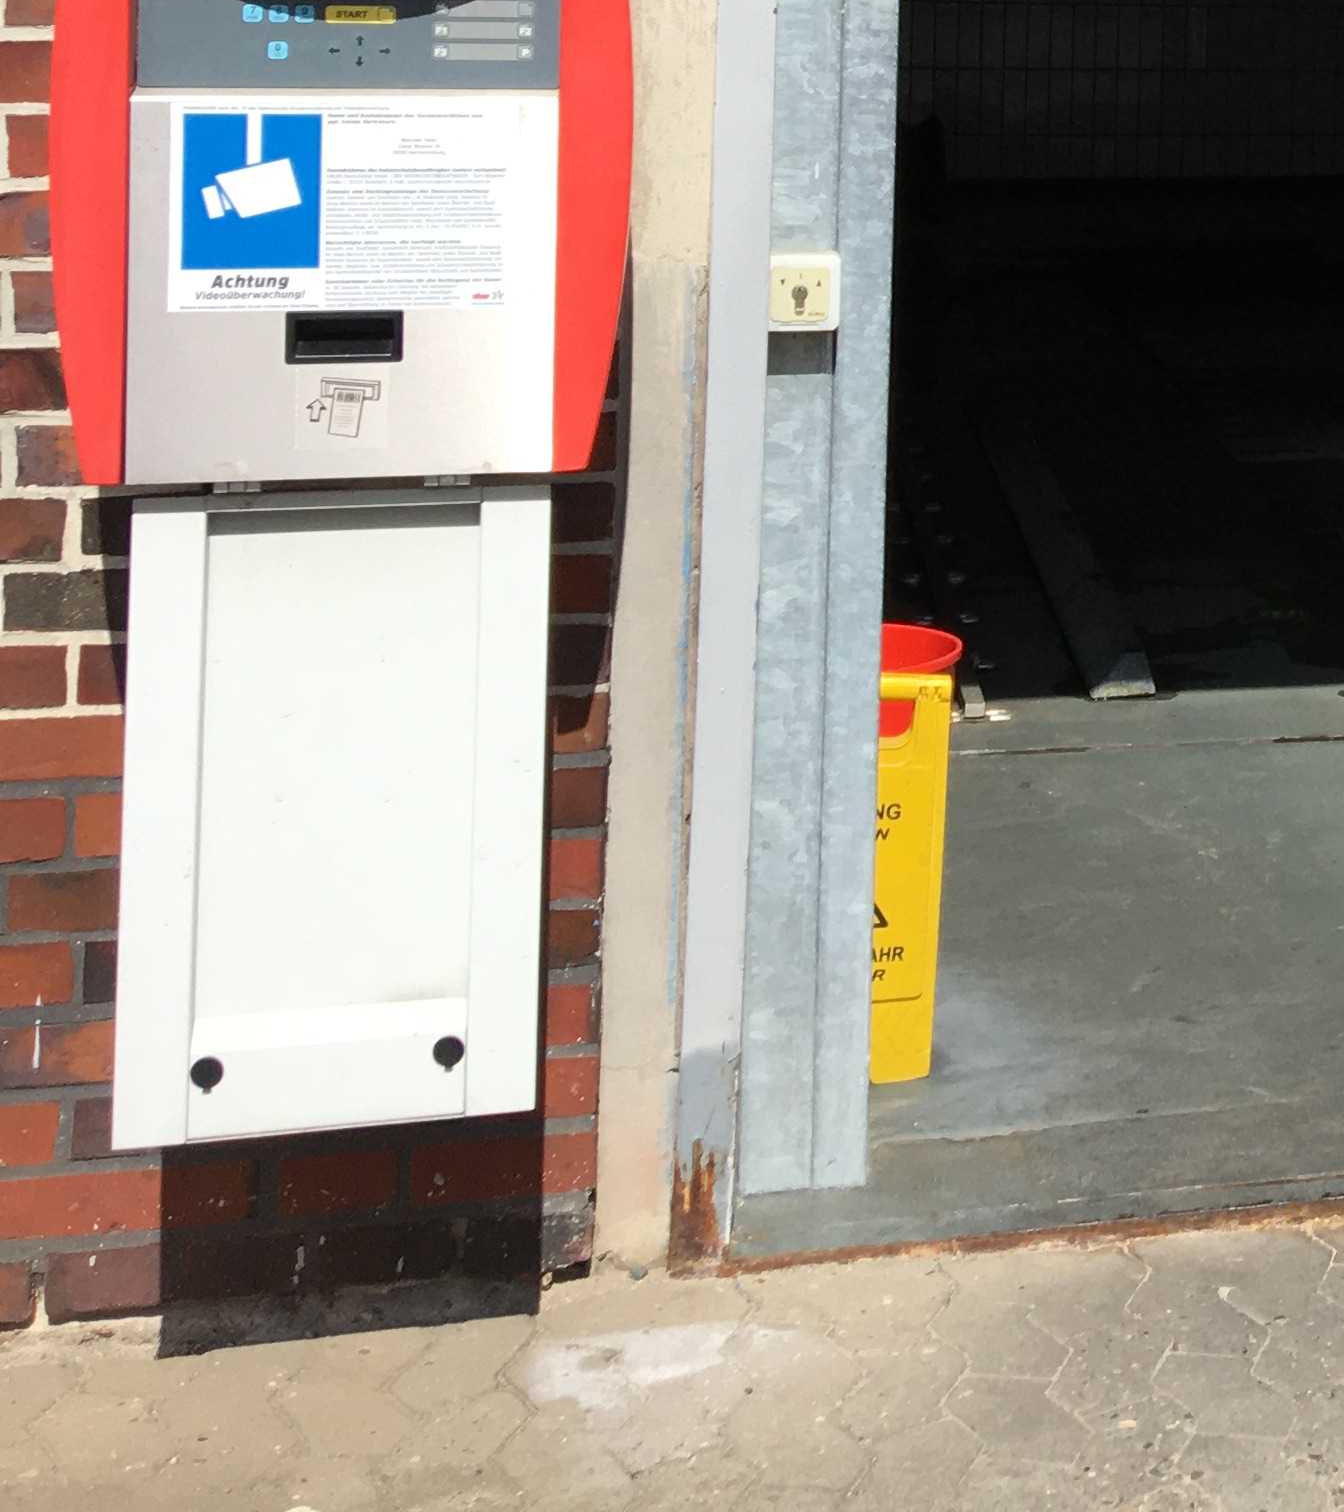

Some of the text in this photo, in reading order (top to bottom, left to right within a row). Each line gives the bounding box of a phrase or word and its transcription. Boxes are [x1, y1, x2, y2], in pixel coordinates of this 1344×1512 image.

[335, 10, 369, 19] START
[434, 24, 532, 37] F1 F2
[211, 274, 290, 290] Achtung
[195, 290, 306, 301] Videoüberwachung!
